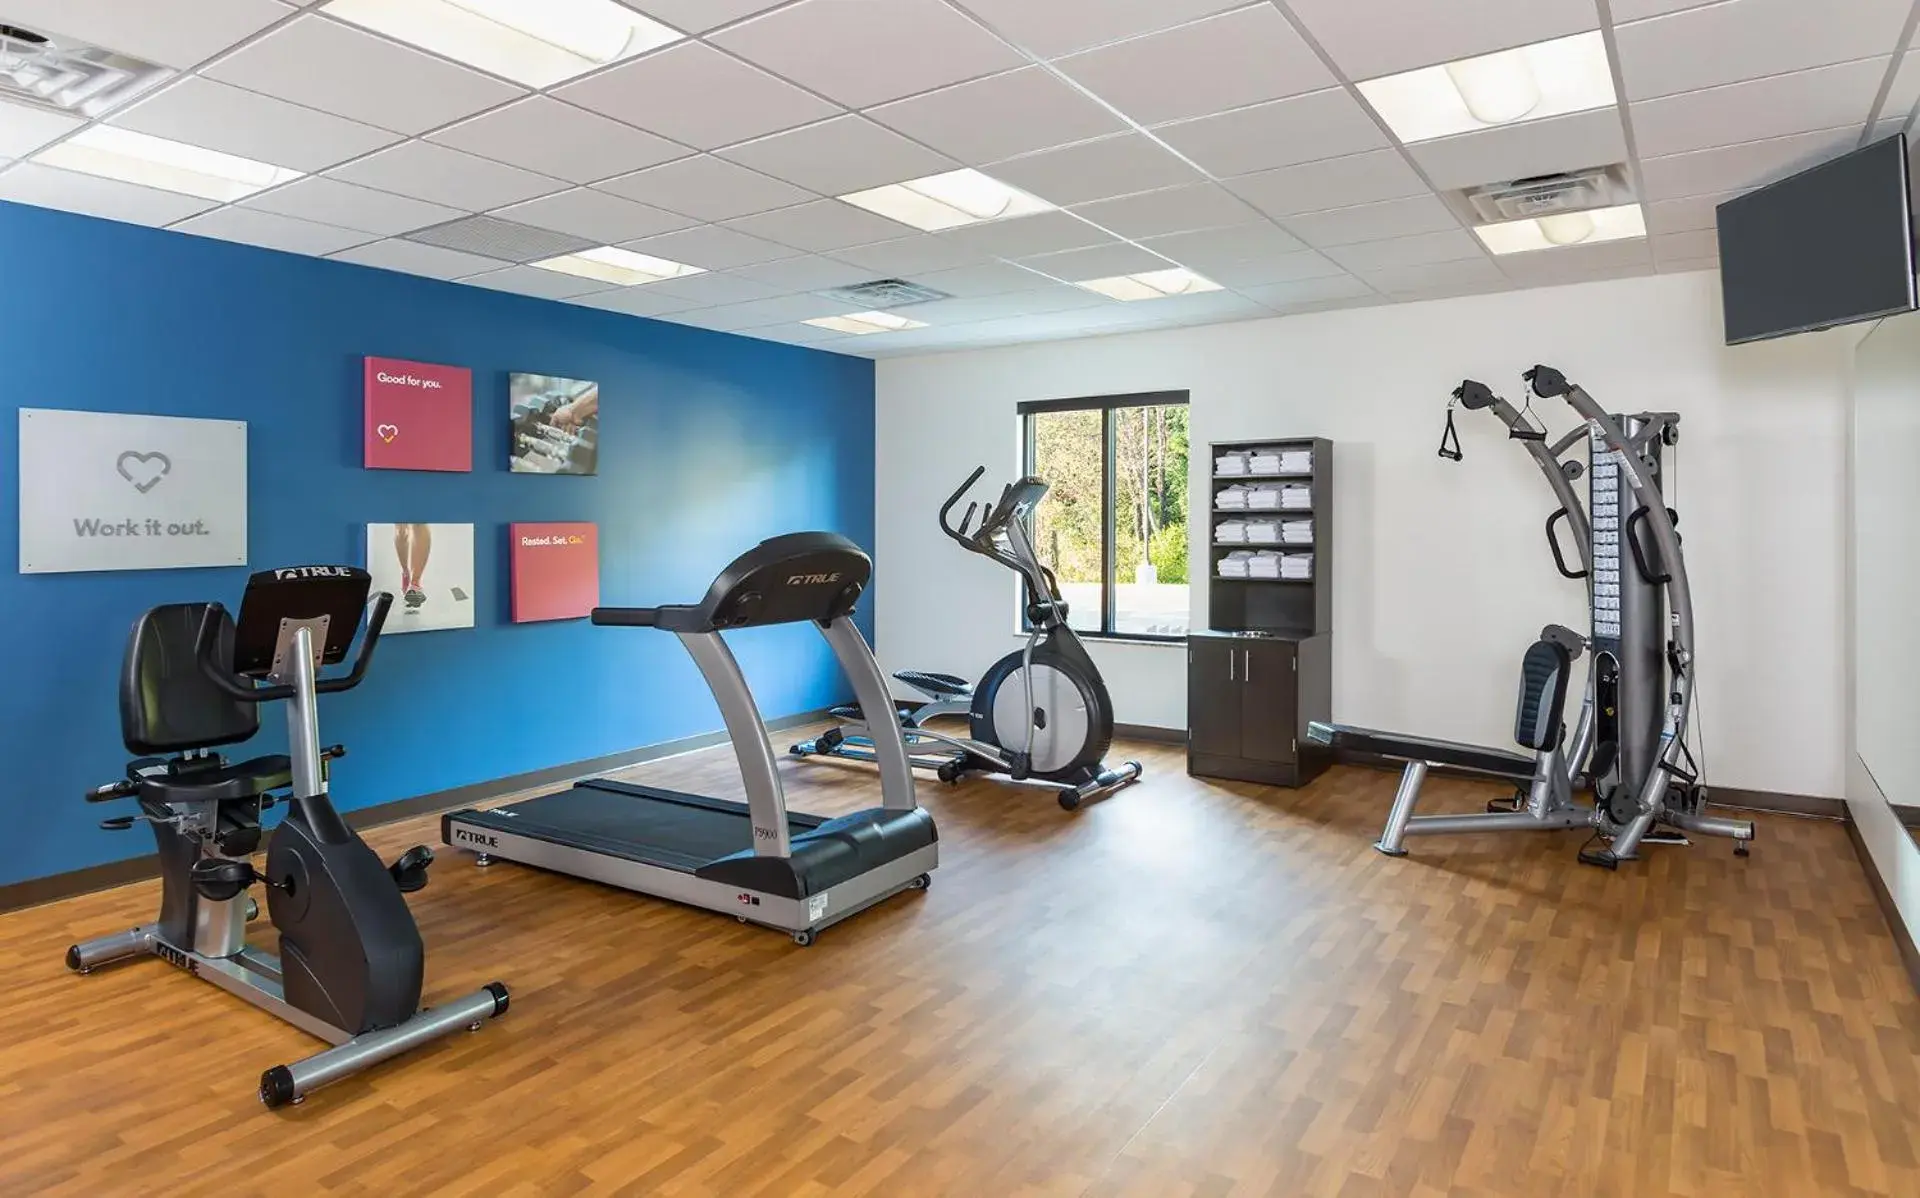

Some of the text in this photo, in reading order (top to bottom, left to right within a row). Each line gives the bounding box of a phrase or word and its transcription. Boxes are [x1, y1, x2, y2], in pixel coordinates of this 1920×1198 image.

[377, 372, 442, 389] Good for you.
[73, 518, 210, 537] Work it out.
[521, 536, 552, 546] Rested.
[552, 535, 568, 545] Set.
[300, 566, 352, 577] TRUE
[804, 572, 840, 584] TRUE
[467, 831, 499, 848] TRUE
